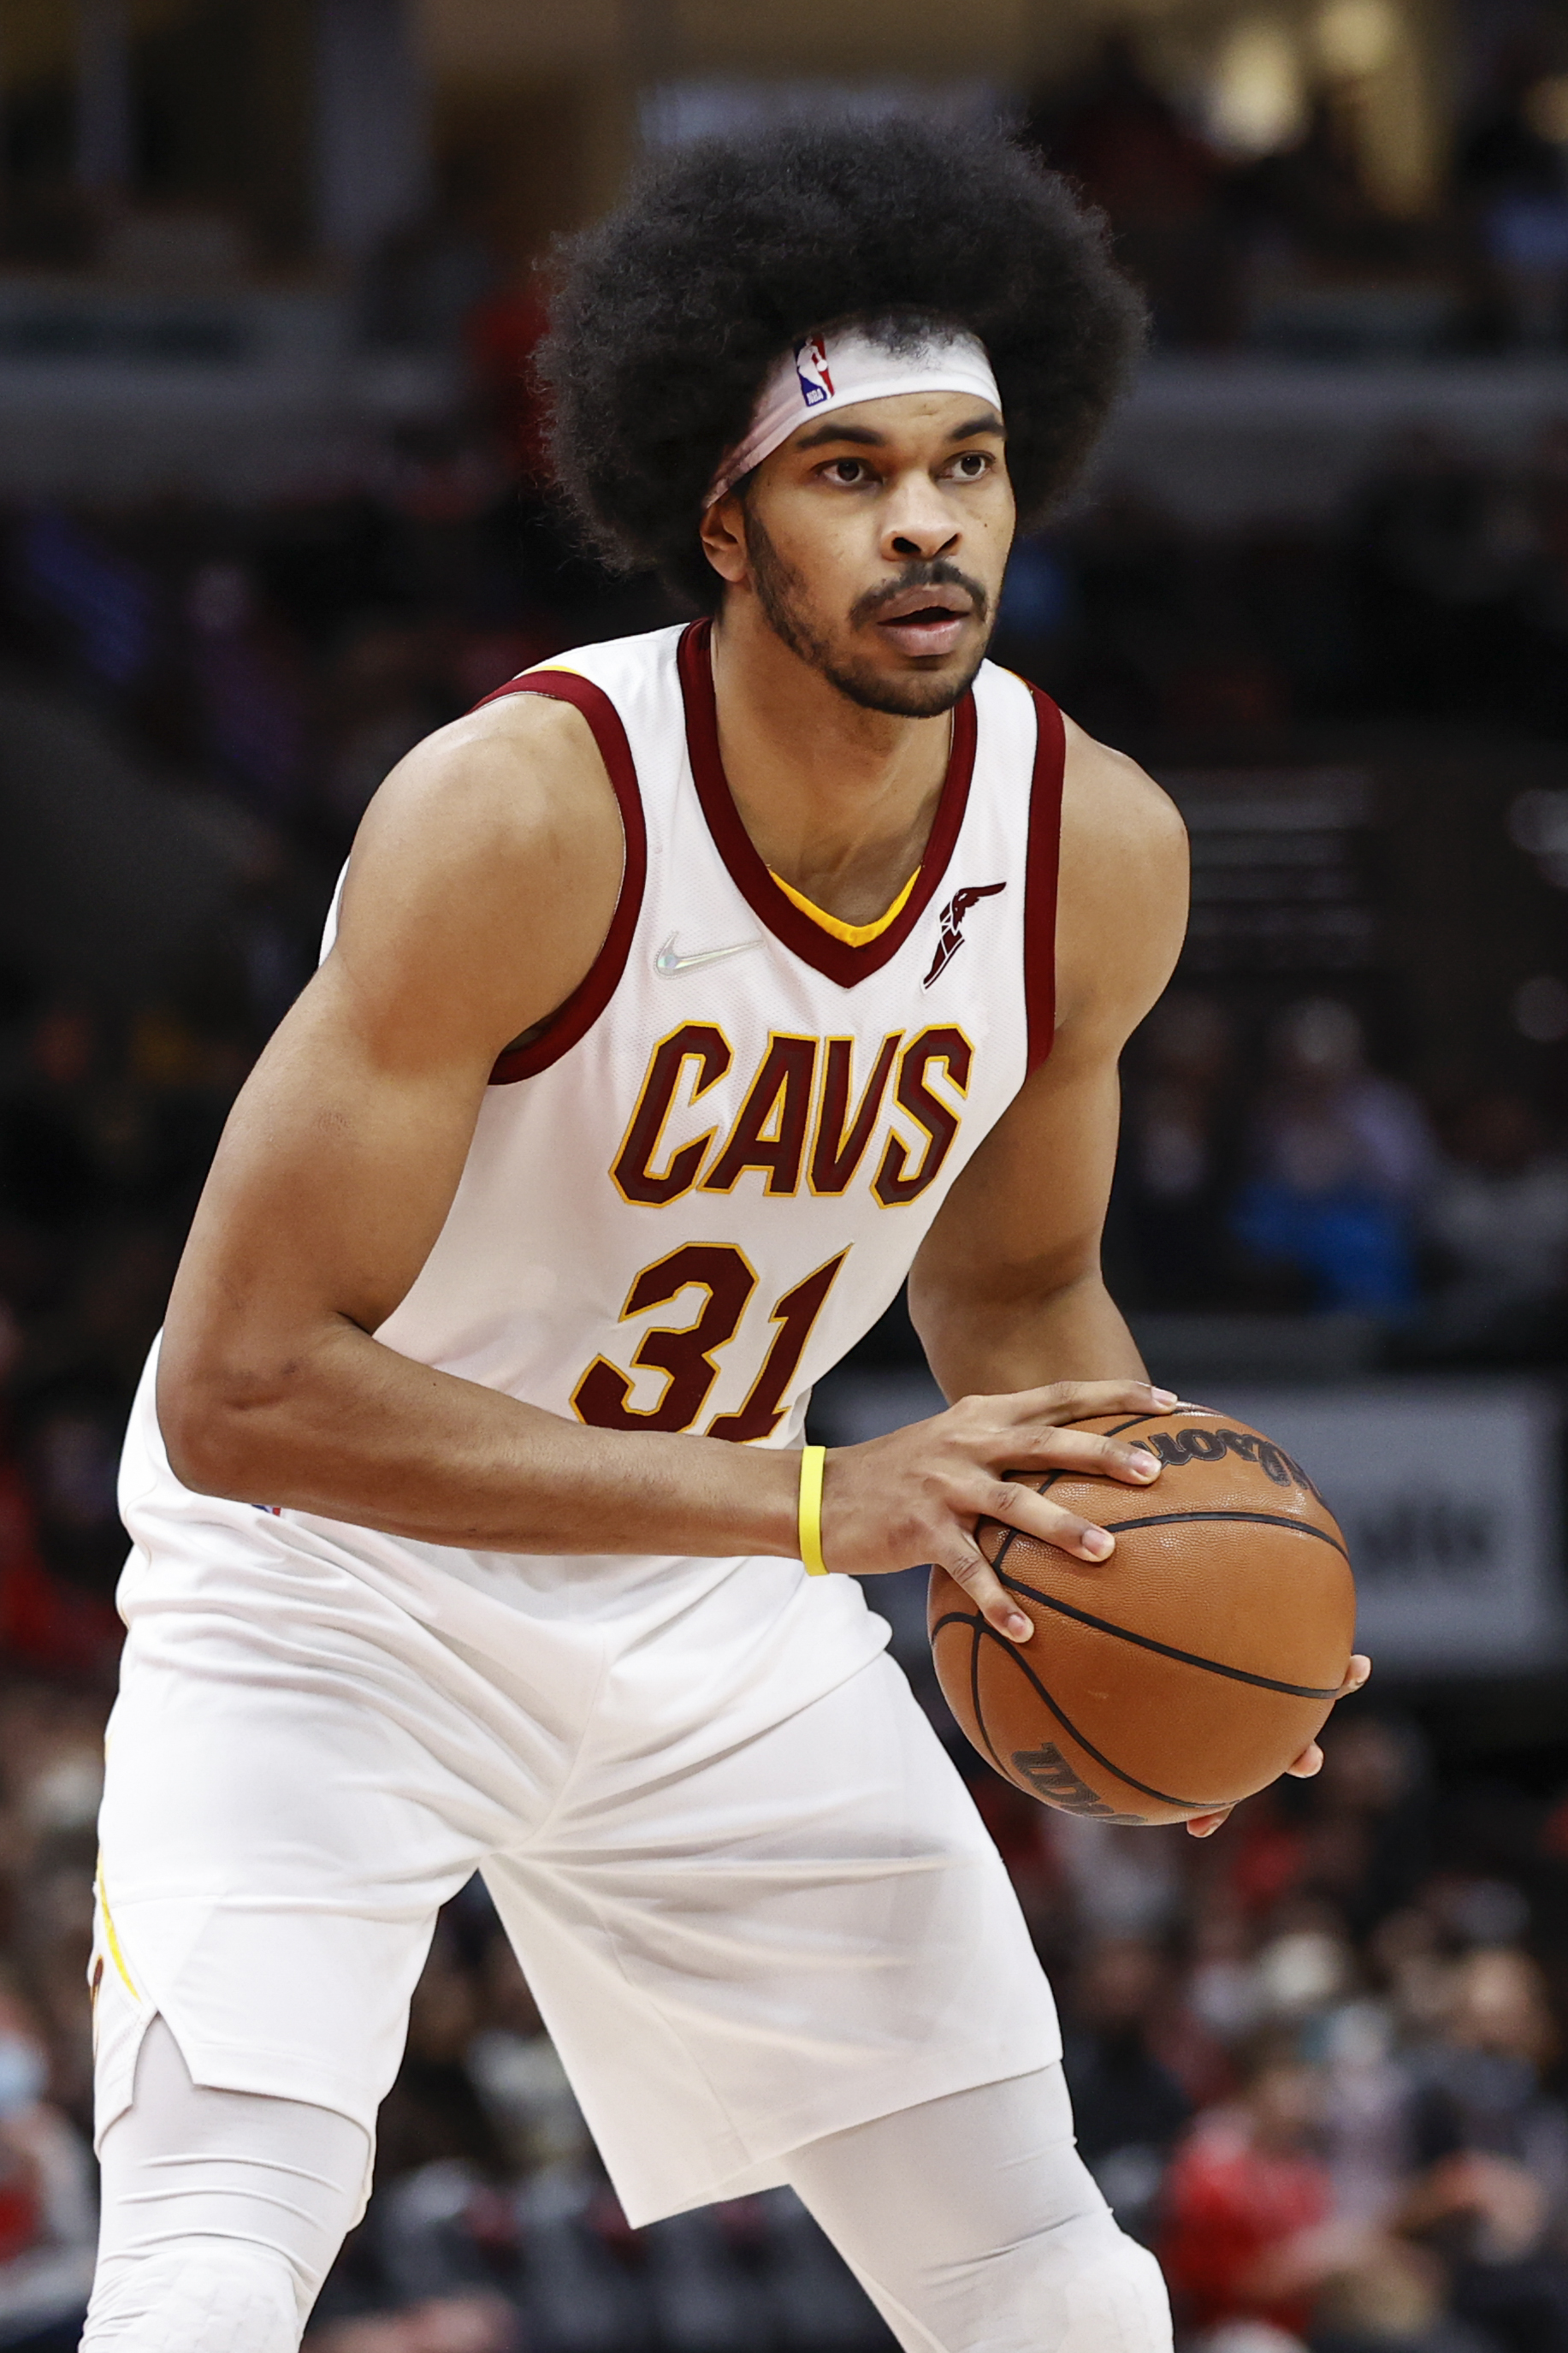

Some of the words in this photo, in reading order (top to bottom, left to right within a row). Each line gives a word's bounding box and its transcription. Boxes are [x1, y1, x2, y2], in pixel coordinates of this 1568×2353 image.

[806, 388, 824, 405] NBA
[608, 1020, 975, 1209] CAVS
[569, 1242, 854, 1443] 31
